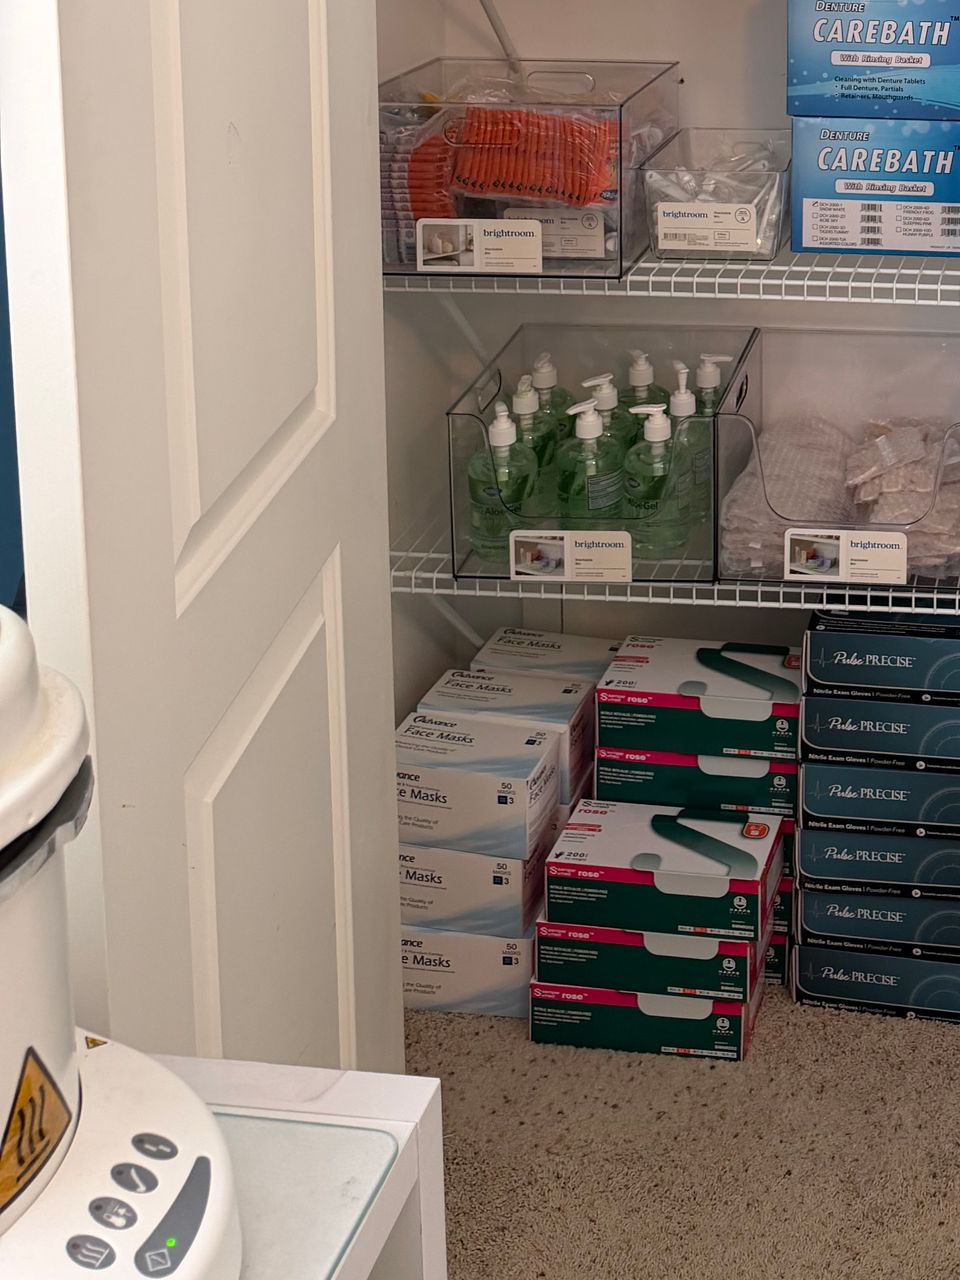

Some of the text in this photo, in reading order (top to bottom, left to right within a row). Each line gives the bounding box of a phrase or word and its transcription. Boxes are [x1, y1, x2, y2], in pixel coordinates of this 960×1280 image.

[815, 0, 865, 13] DENTURE
[840, 54, 923, 65] With Rinsing Basket
[834, 76, 862, 84] Cleaning
[820, 129, 870, 141] DENTURE
[663, 210, 708, 220] brightroom
[483, 228, 535, 239] brightroom
[574, 540, 624, 549] brightroom
[850, 540, 900, 550] brightroom
[865, 655, 913, 668] PRECISE
[445, 679, 513, 693] Face Masks
[413, 716, 457, 727] Advance
[861, 721, 908, 734] PRECISE
[405, 727, 475, 744] Face Masks
[410, 789, 447, 804] Masks
[861, 788, 908, 801] PRECISE
[856, 850, 903, 864] PRECISE
[405, 870, 442, 884] Masks
[857, 909, 904, 922] PRECISE
[413, 954, 451, 968] Masks
